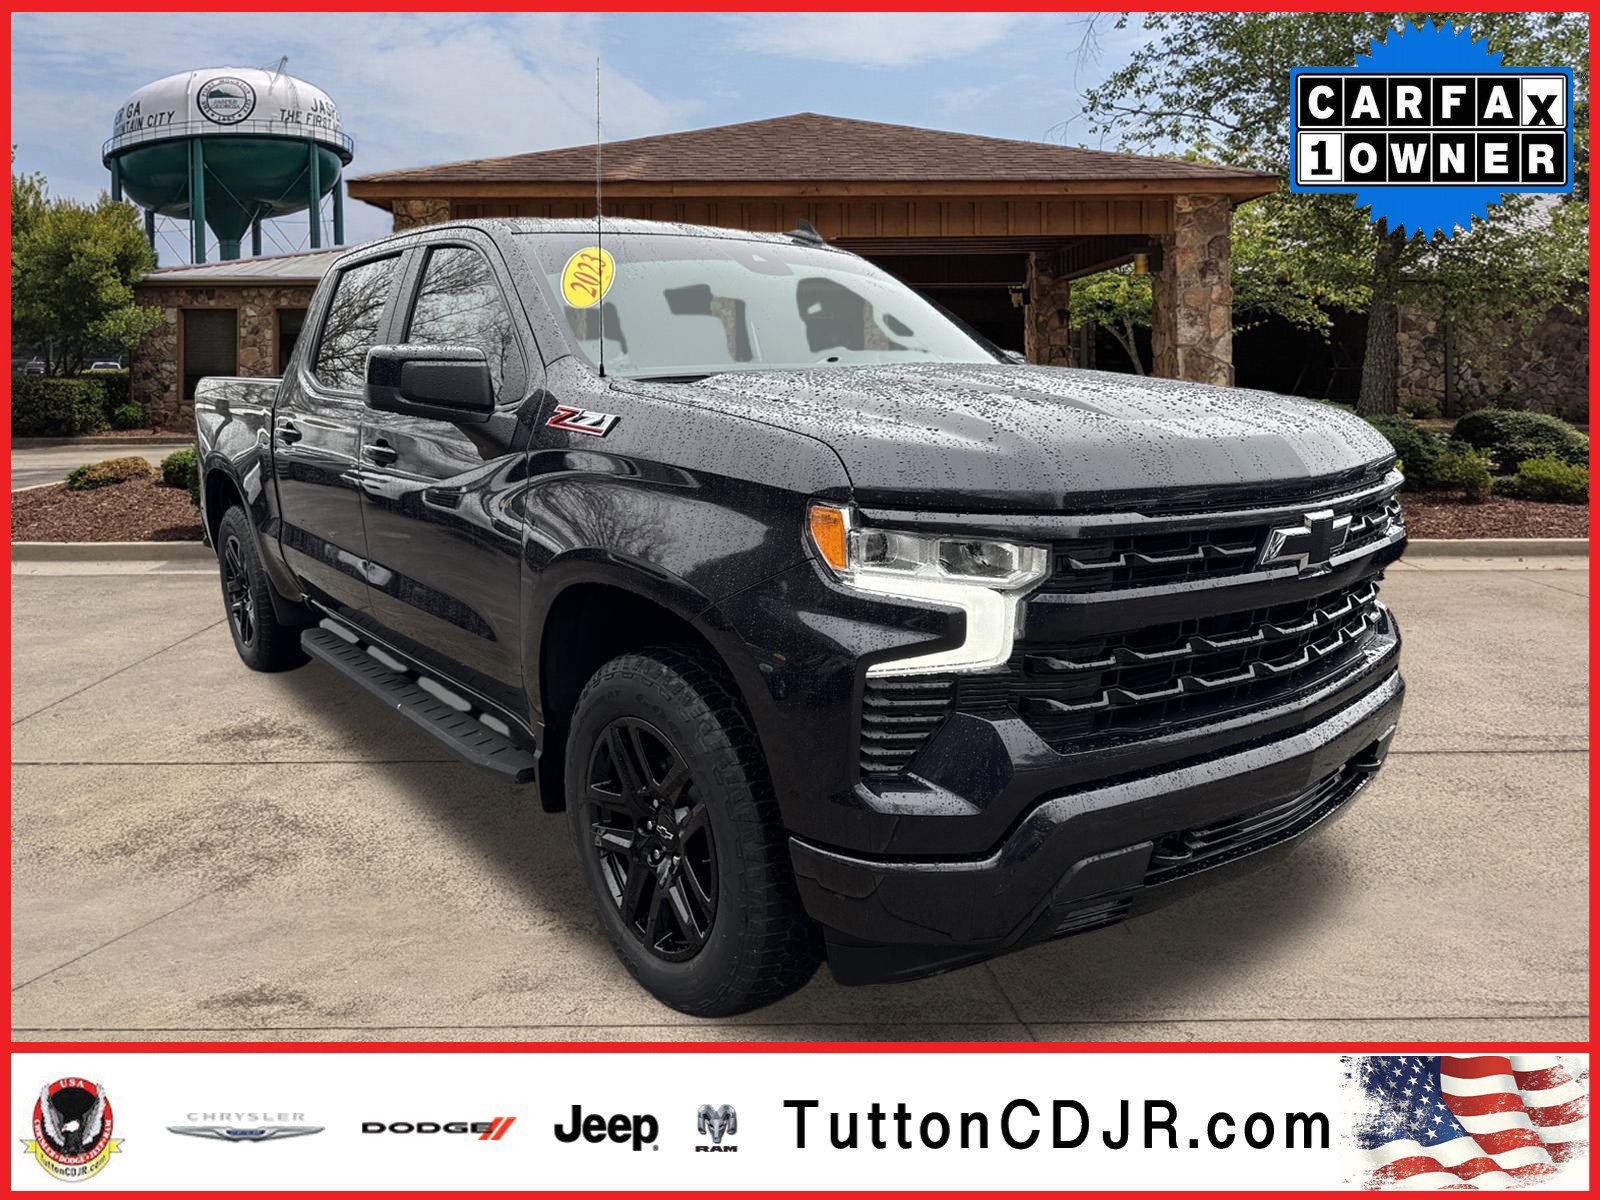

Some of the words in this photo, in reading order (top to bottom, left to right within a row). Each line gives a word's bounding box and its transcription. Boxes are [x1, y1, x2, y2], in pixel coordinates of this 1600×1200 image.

[126, 100, 141, 119] GA
[147, 110, 176, 127] CITY
[280, 108, 302, 124] THE
[570, 253, 606, 298] 2023
[546, 404, 621, 438] Z71
